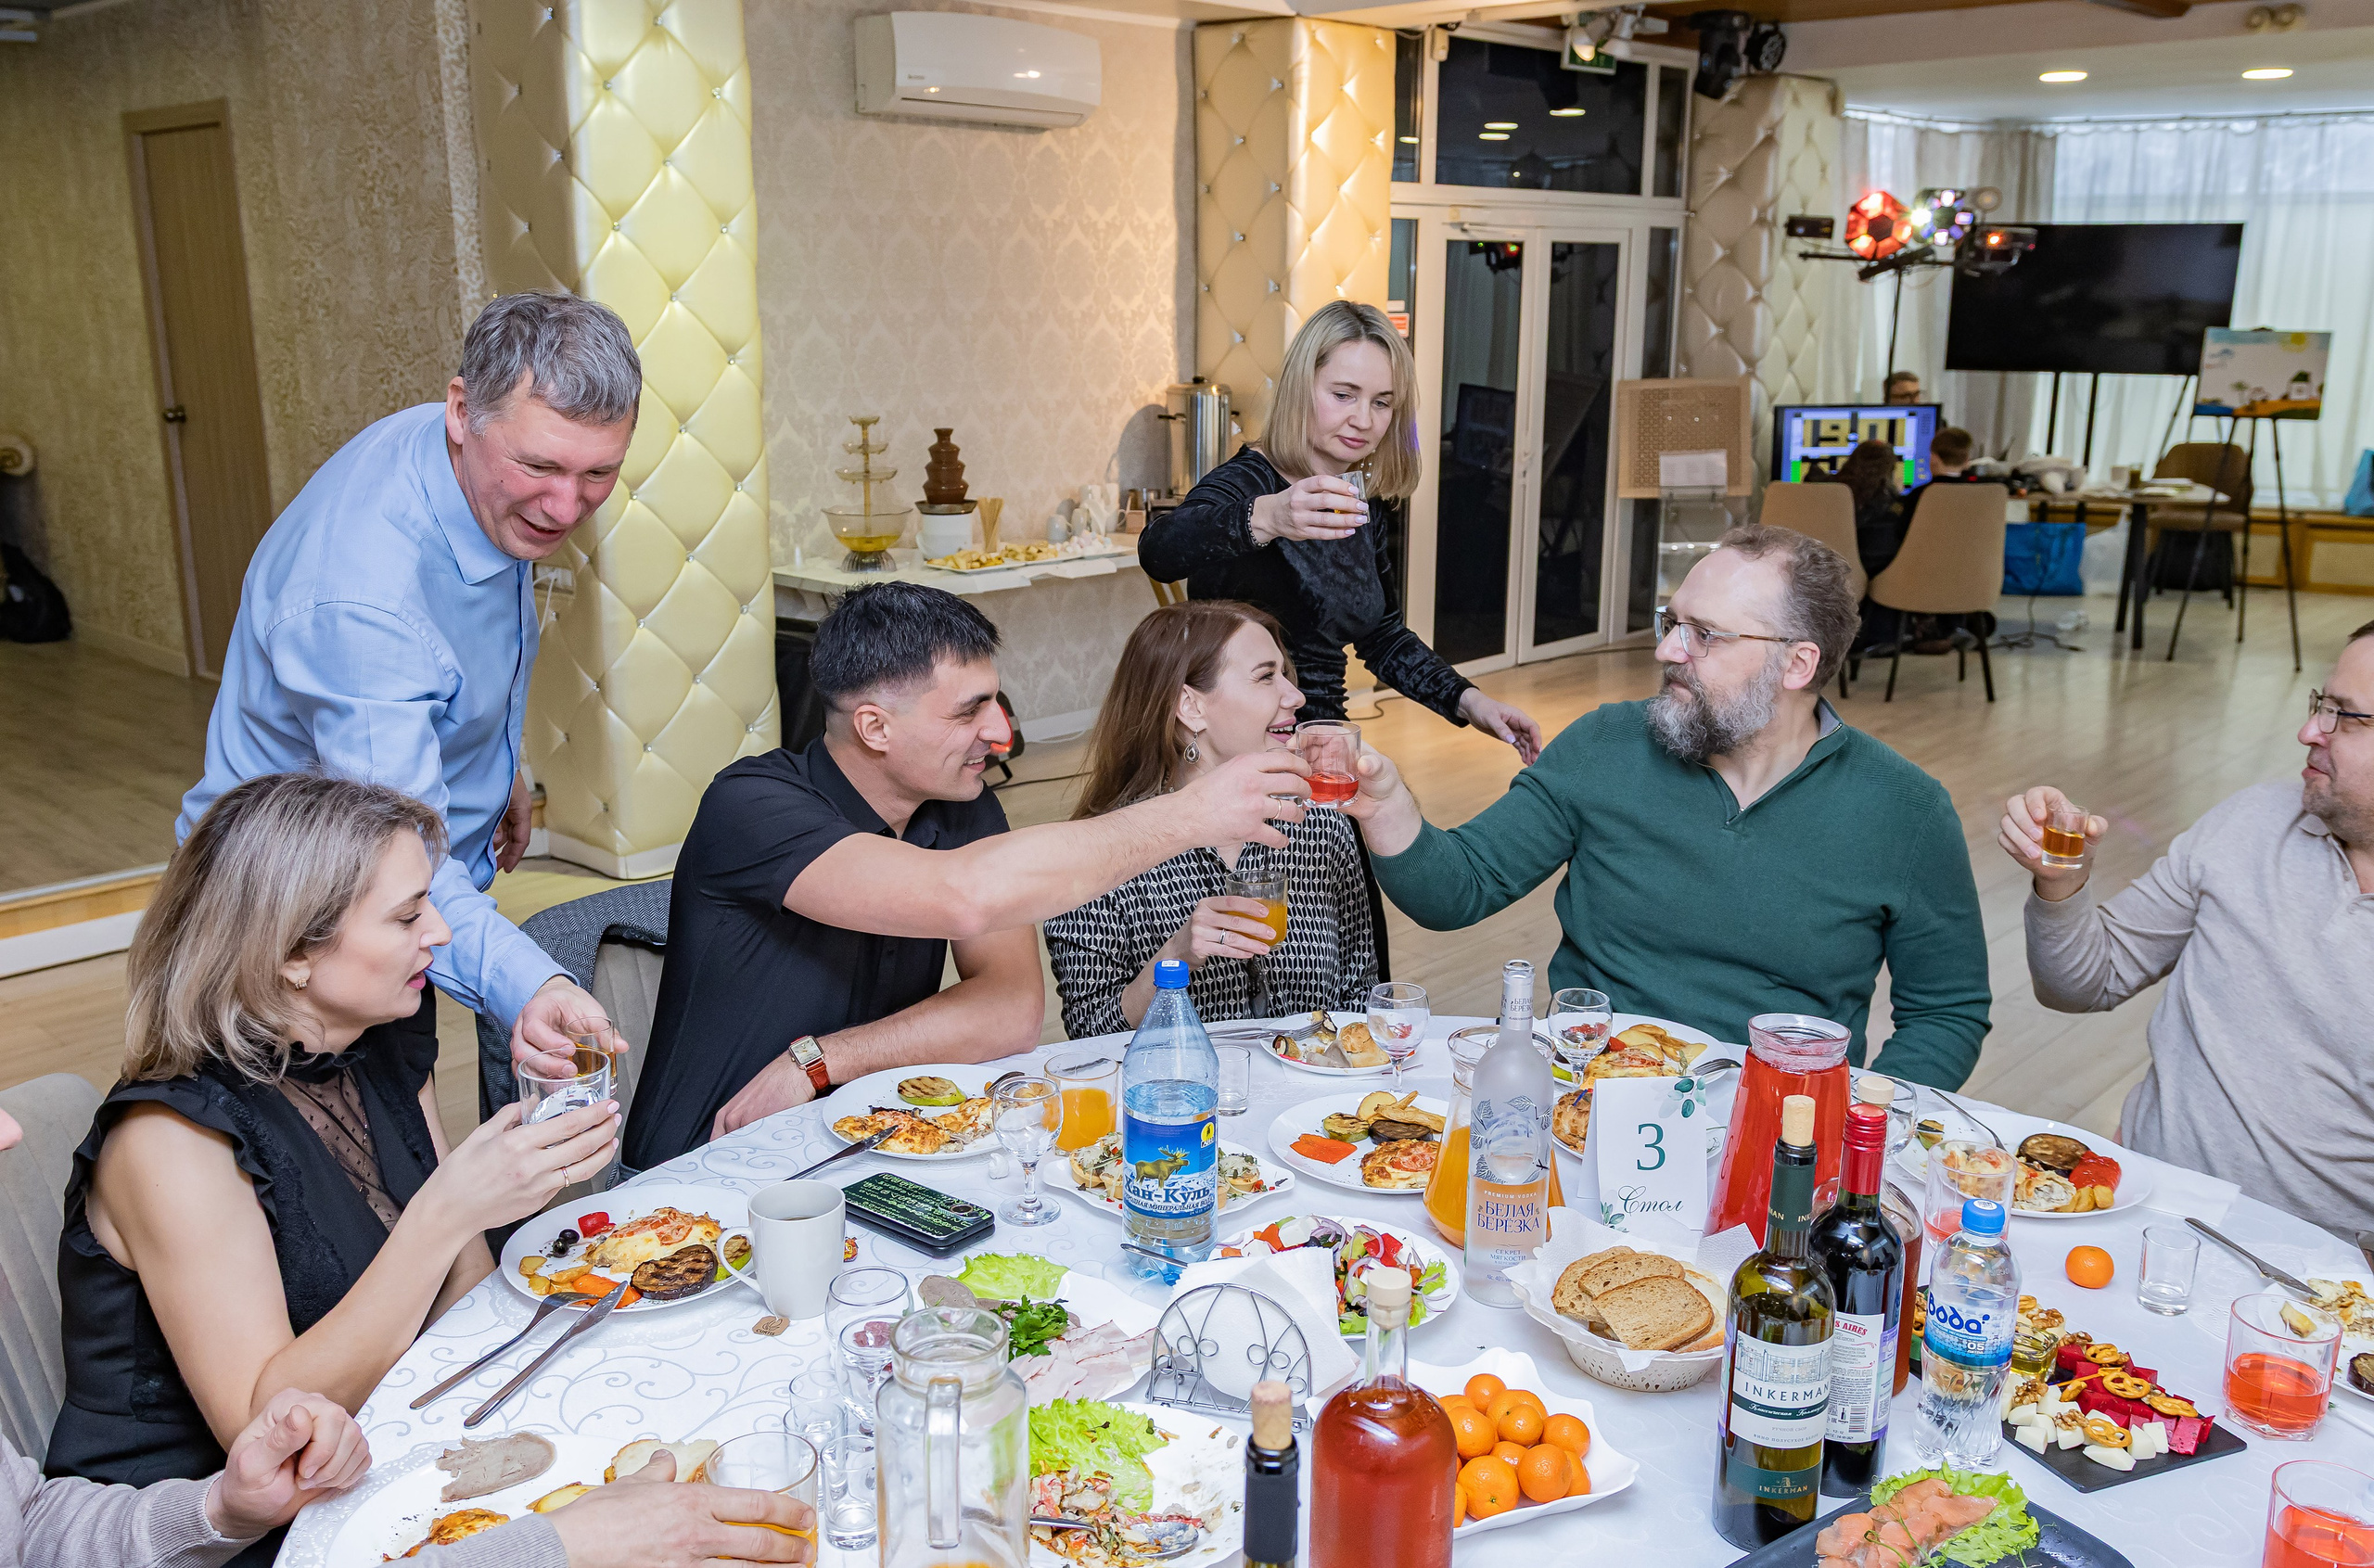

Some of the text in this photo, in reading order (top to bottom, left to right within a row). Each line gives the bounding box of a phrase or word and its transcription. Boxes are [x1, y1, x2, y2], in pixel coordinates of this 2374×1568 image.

[1637, 1123, 1666, 1170] 3
[1125, 1175, 1210, 1205] Хан-Куль
[1484, 1190, 1514, 1199] PREMIUM
[1149, 1202, 1200, 1212] МИНЕРАЛЬНАЯ
[1486, 1200, 1534, 1218] БЕЛАЯ
[1618, 1185, 1684, 1217] Стол
[1477, 1213, 1540, 1234] БЕРЁЗКА
[1842, 1322, 1868, 1335] AIRES
[1744, 1381, 1829, 1401] INKERMAN
[1758, 1484, 1808, 1495] INKERMAN
